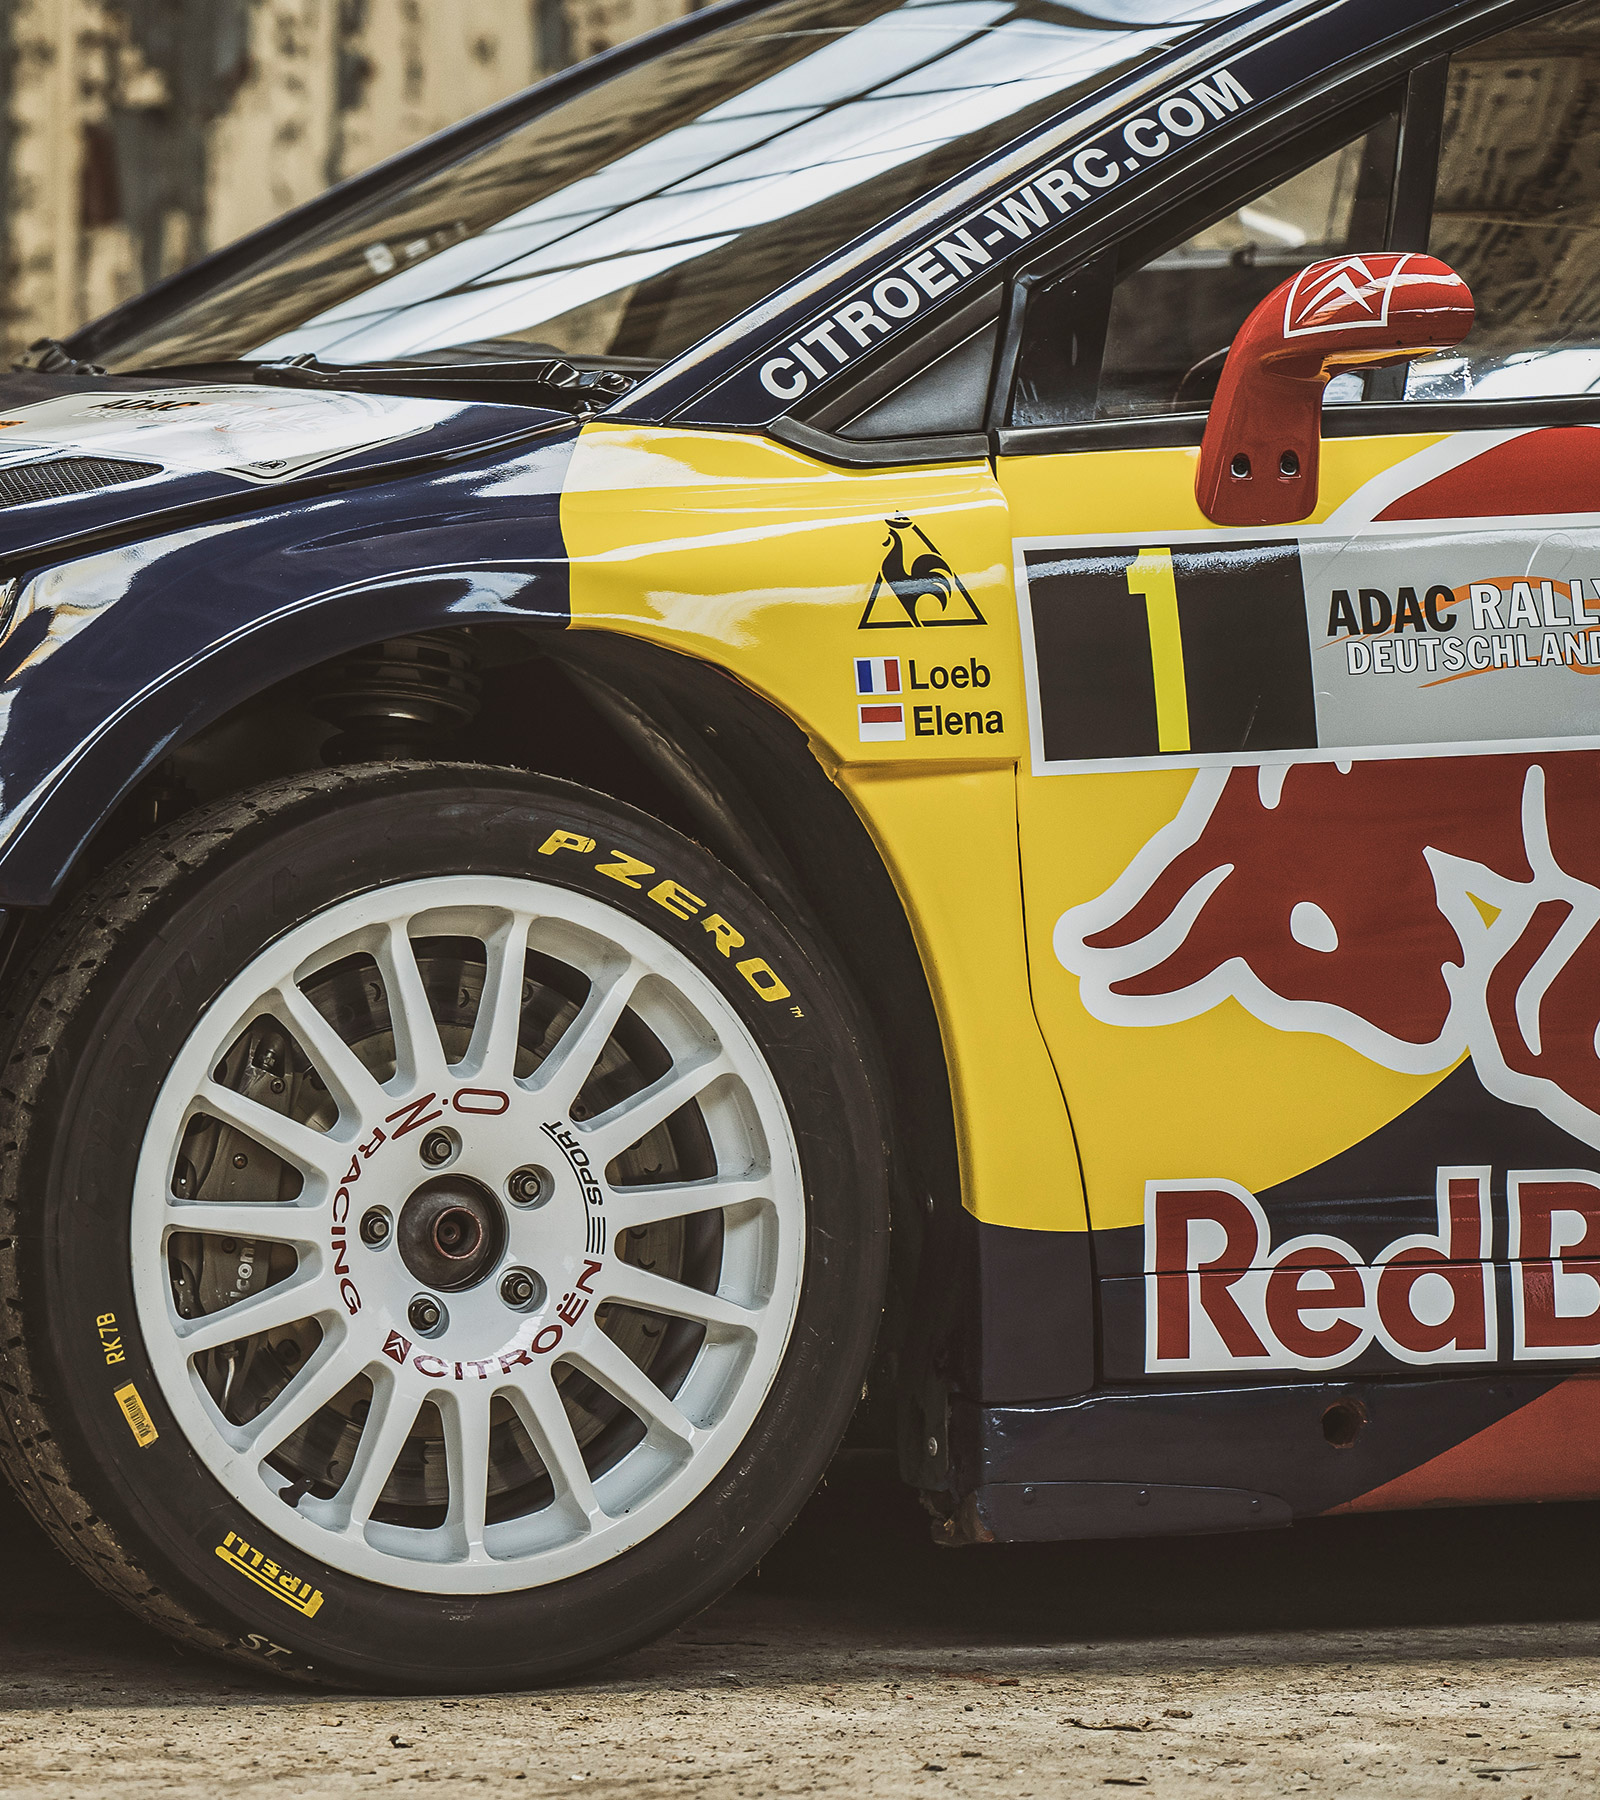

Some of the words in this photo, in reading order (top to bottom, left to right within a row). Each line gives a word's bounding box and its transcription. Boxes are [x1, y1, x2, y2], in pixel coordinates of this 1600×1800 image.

[759, 69, 1254, 400] CITROEN-WRC.COM
[908, 658, 991, 690] Loeb
[1126, 547, 1191, 752] 1
[1326, 584, 1457, 636] ADAC
[913, 705, 1004, 736] Elena
[331, 1127, 387, 1316] RACING
[413, 1259, 602, 1380] CITROËN
[544, 1120, 603, 1206] SPORT
[1144, 1165, 1498, 1373] Red
[96, 1312, 126, 1365] RK7B
[215, 1531, 324, 1618] PIRELLI
